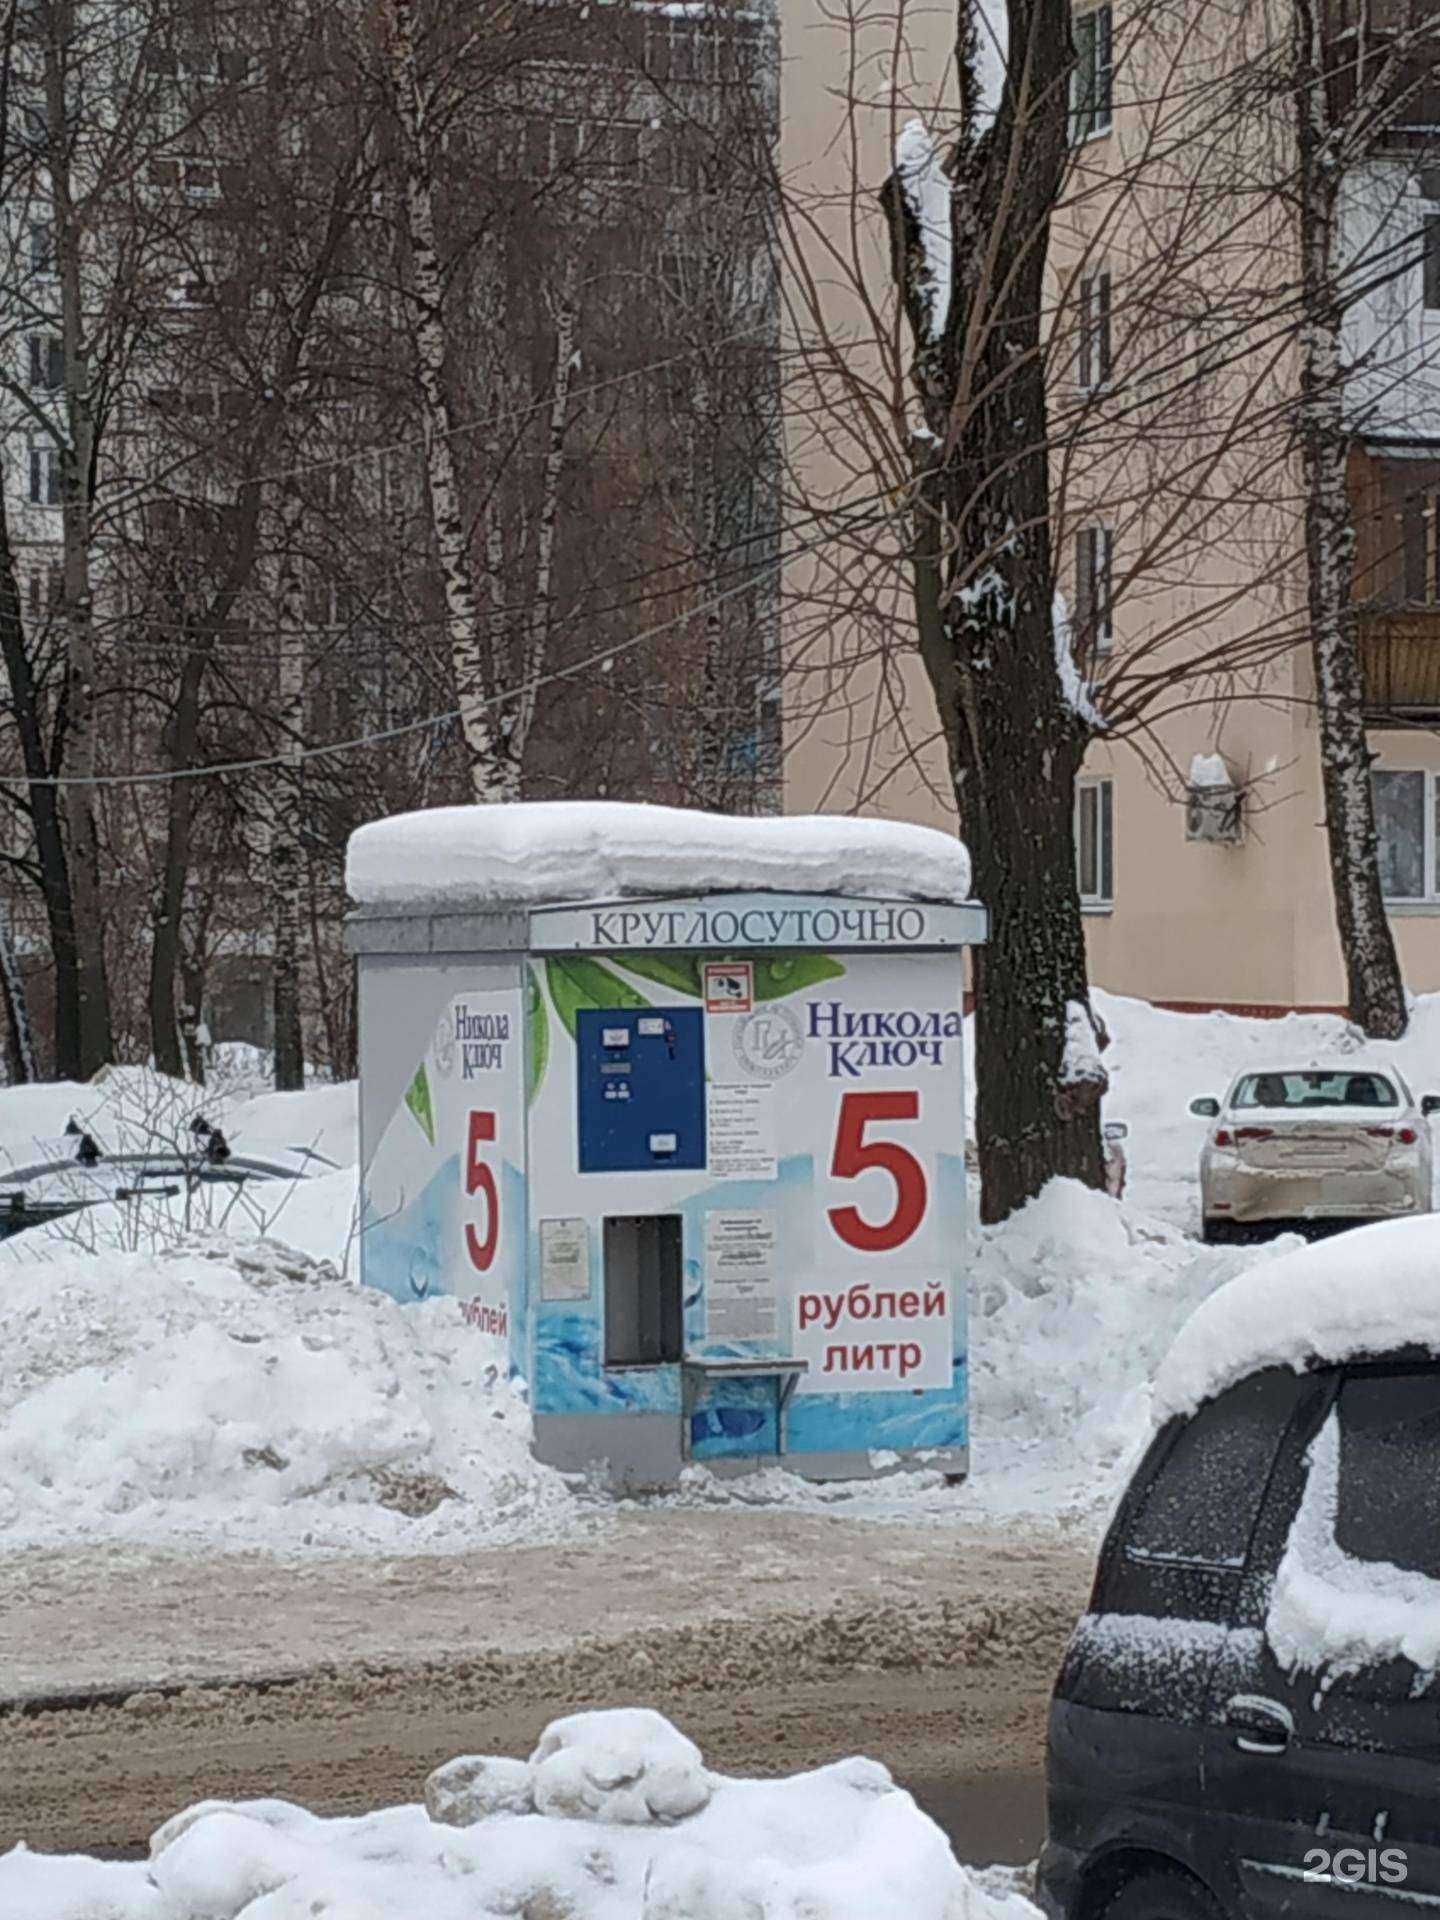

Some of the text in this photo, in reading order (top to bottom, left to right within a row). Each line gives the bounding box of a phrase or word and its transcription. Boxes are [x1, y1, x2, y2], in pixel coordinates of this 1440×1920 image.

[591, 908, 925, 944] КРУГЛОСУТОЧНО
[454, 1004, 510, 1040] Никола
[806, 1001, 963, 1038] Никола
[462, 1043, 502, 1079] Ключ
[828, 1040, 943, 1077] Ключ
[827, 1091, 928, 1252] 5
[465, 1110, 499, 1272] 5
[799, 1282, 946, 1330] рублей
[822, 1343, 922, 1378] литр
